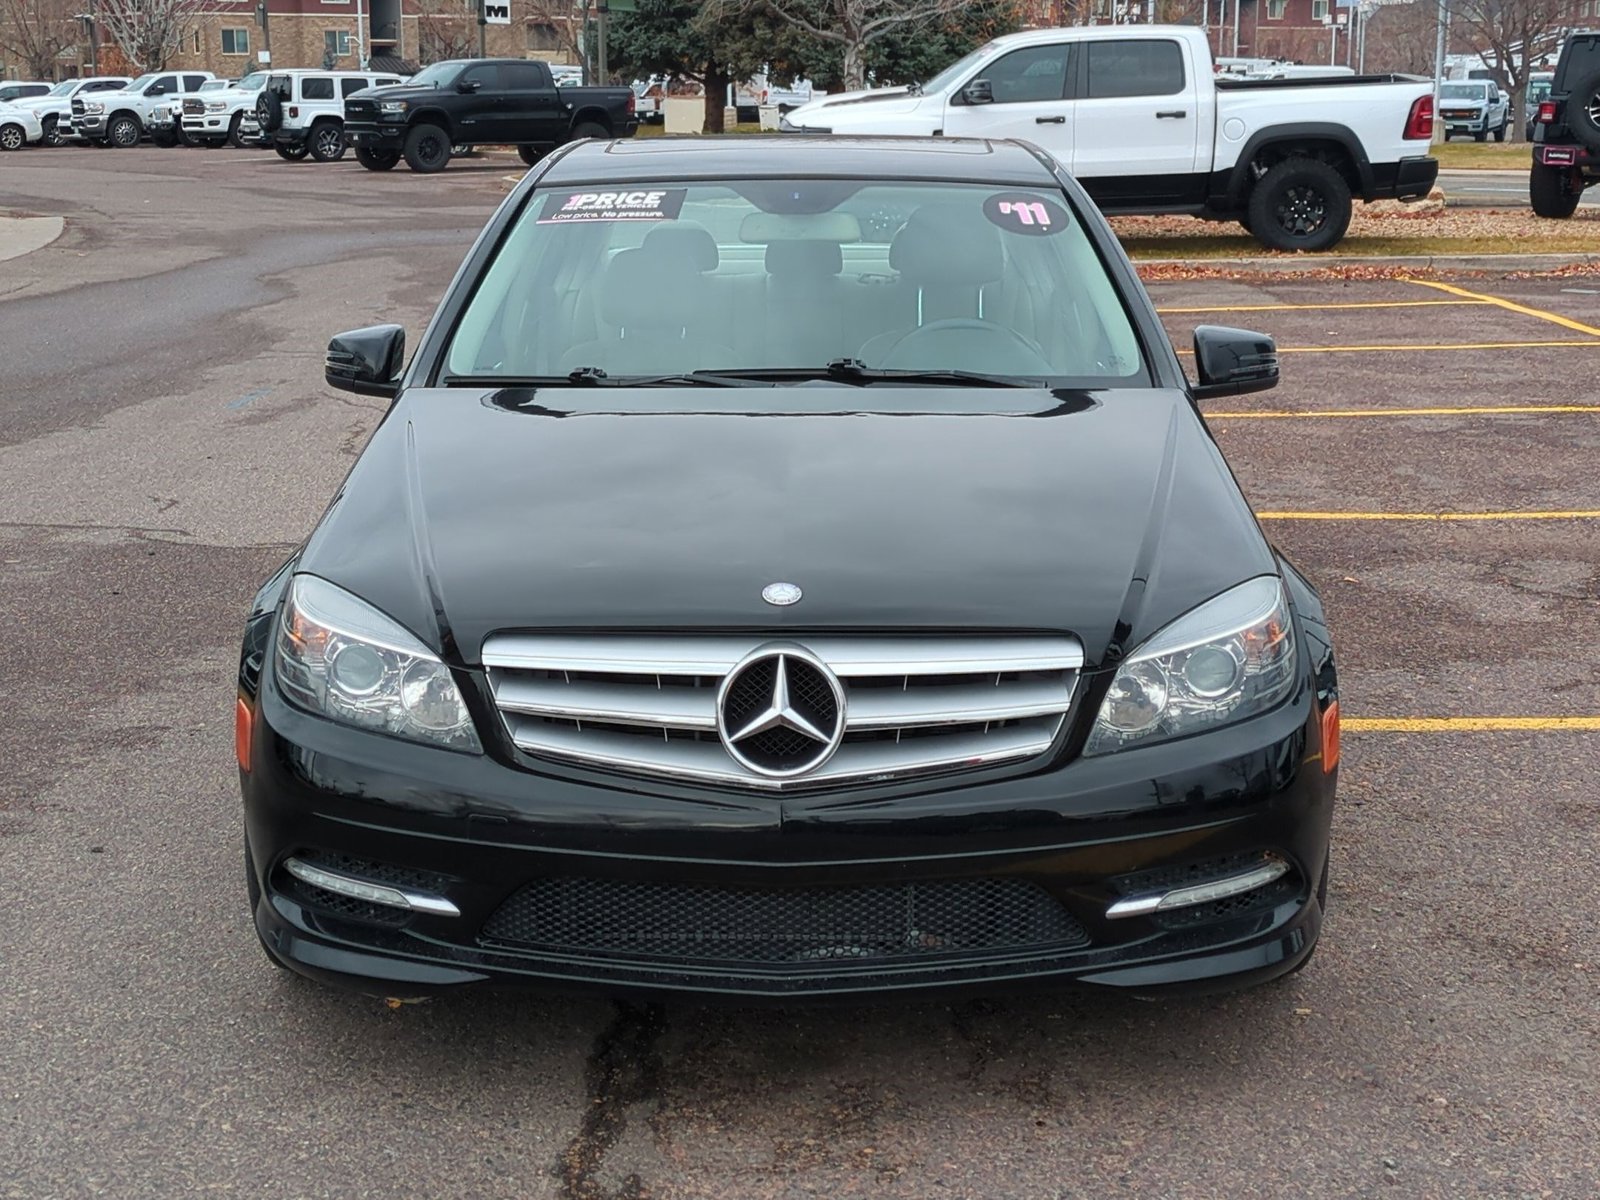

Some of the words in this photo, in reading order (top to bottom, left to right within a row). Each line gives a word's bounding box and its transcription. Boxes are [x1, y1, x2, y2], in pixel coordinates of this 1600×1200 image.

[552, 212, 573, 220] Low
[573, 211, 598, 219] price.
[617, 210, 664, 218] pressure.
